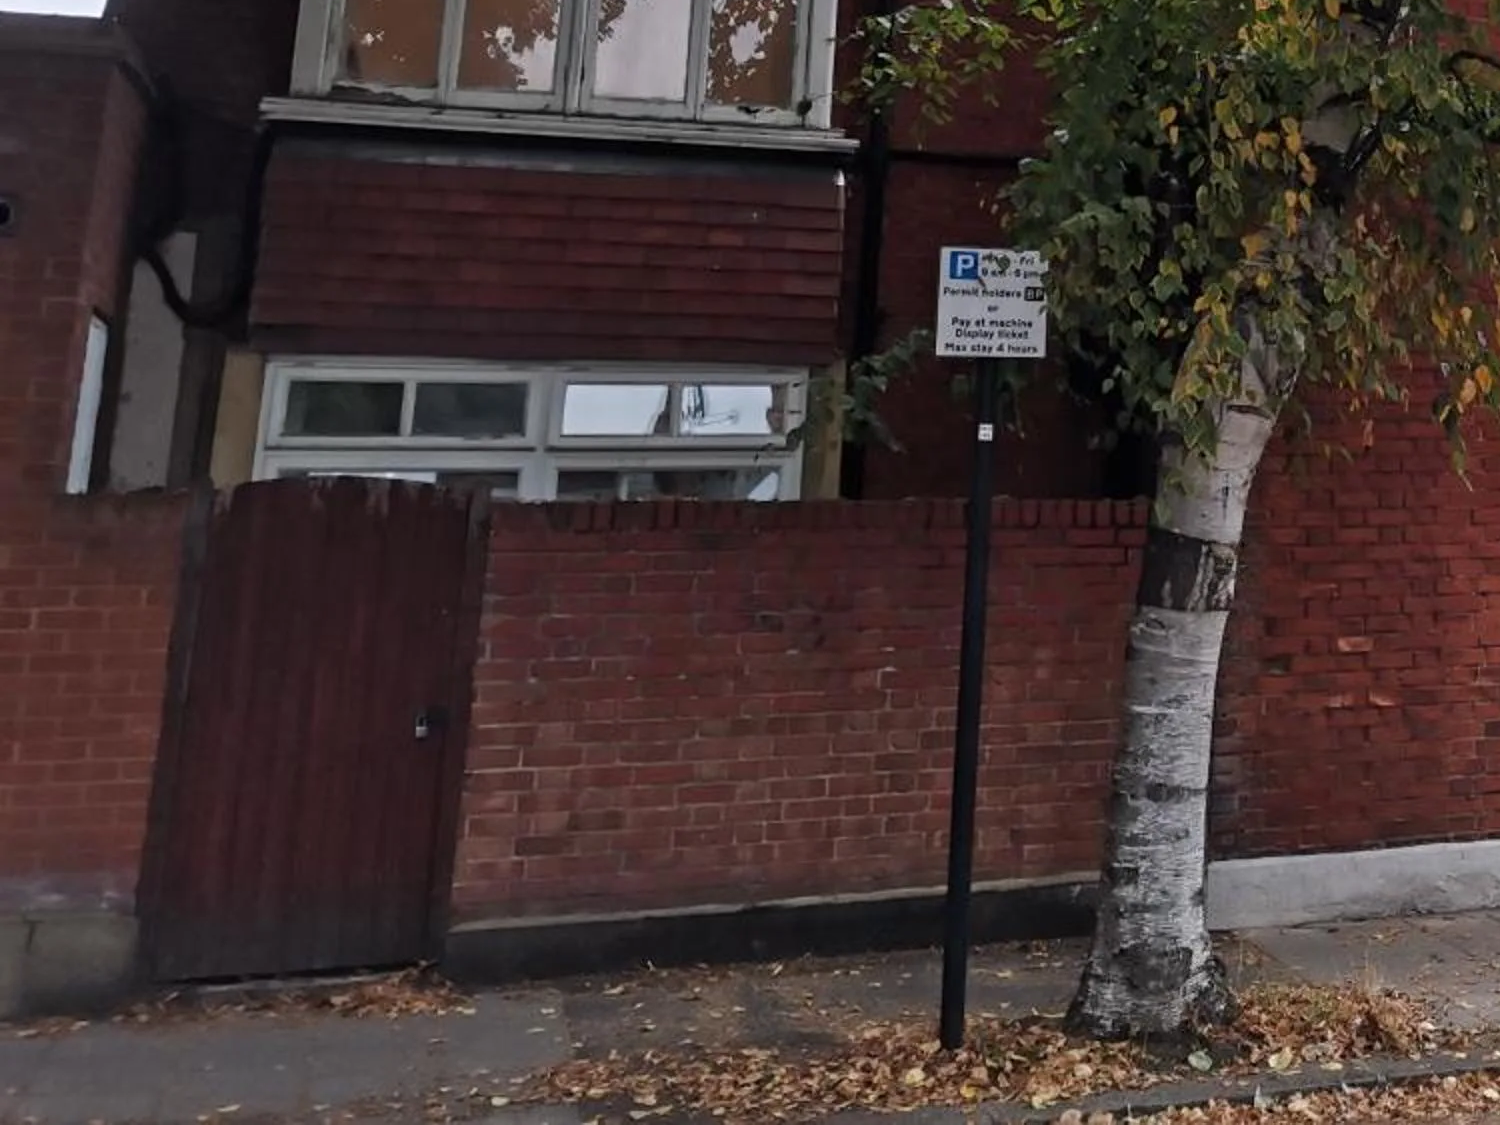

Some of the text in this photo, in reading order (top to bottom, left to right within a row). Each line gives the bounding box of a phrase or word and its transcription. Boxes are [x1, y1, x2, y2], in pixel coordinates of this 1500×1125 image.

[957, 254, 975, 277] P
[943, 287, 979, 297] Permit
[981, 287, 1022, 298] holders
[951, 316, 1033, 328] Pay at machine
[955, 328, 1029, 339] Display ticket
[945, 342, 967, 352] Max
[971, 343, 993, 354] stay
[1007, 343, 1038, 353] hours
